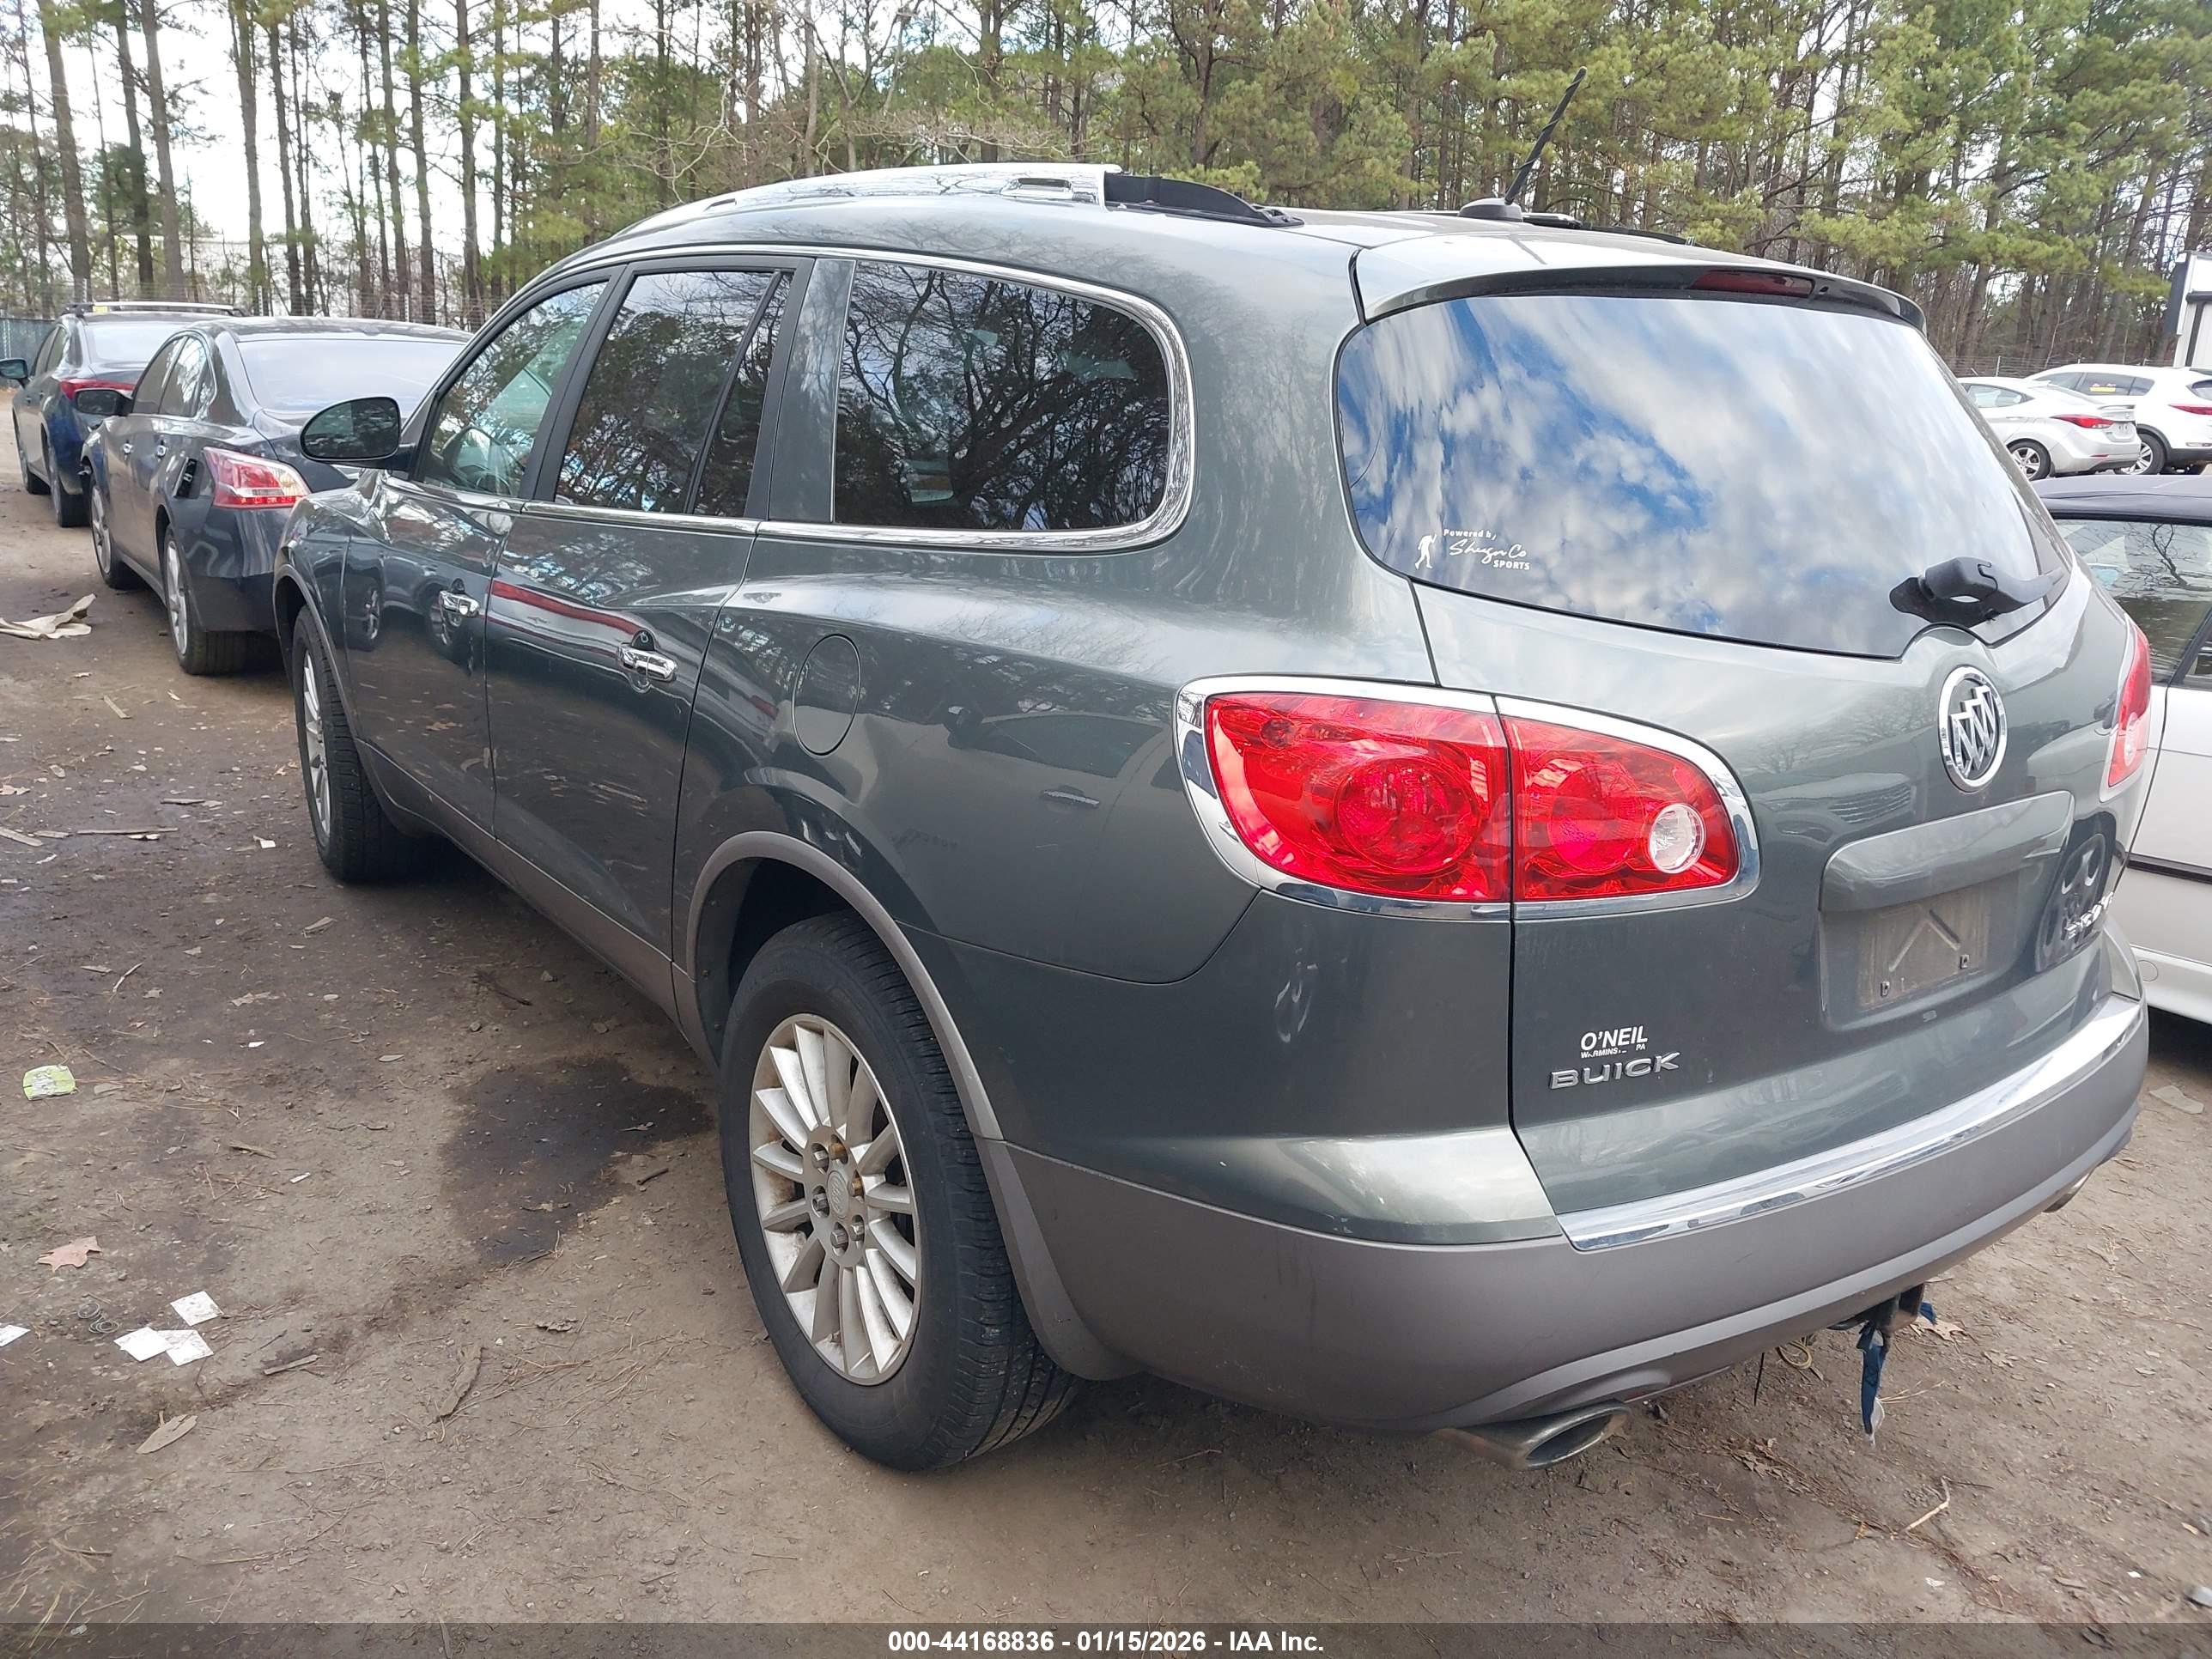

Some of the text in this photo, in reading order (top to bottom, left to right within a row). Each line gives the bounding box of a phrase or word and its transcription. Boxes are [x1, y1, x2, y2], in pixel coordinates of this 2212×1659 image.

[1443, 529, 1484, 538] Powered
[1493, 560, 1529, 570] SPORTS
[1581, 1025, 1648, 1050] O'NEIL
[1550, 1052, 1680, 1090] BUICK
